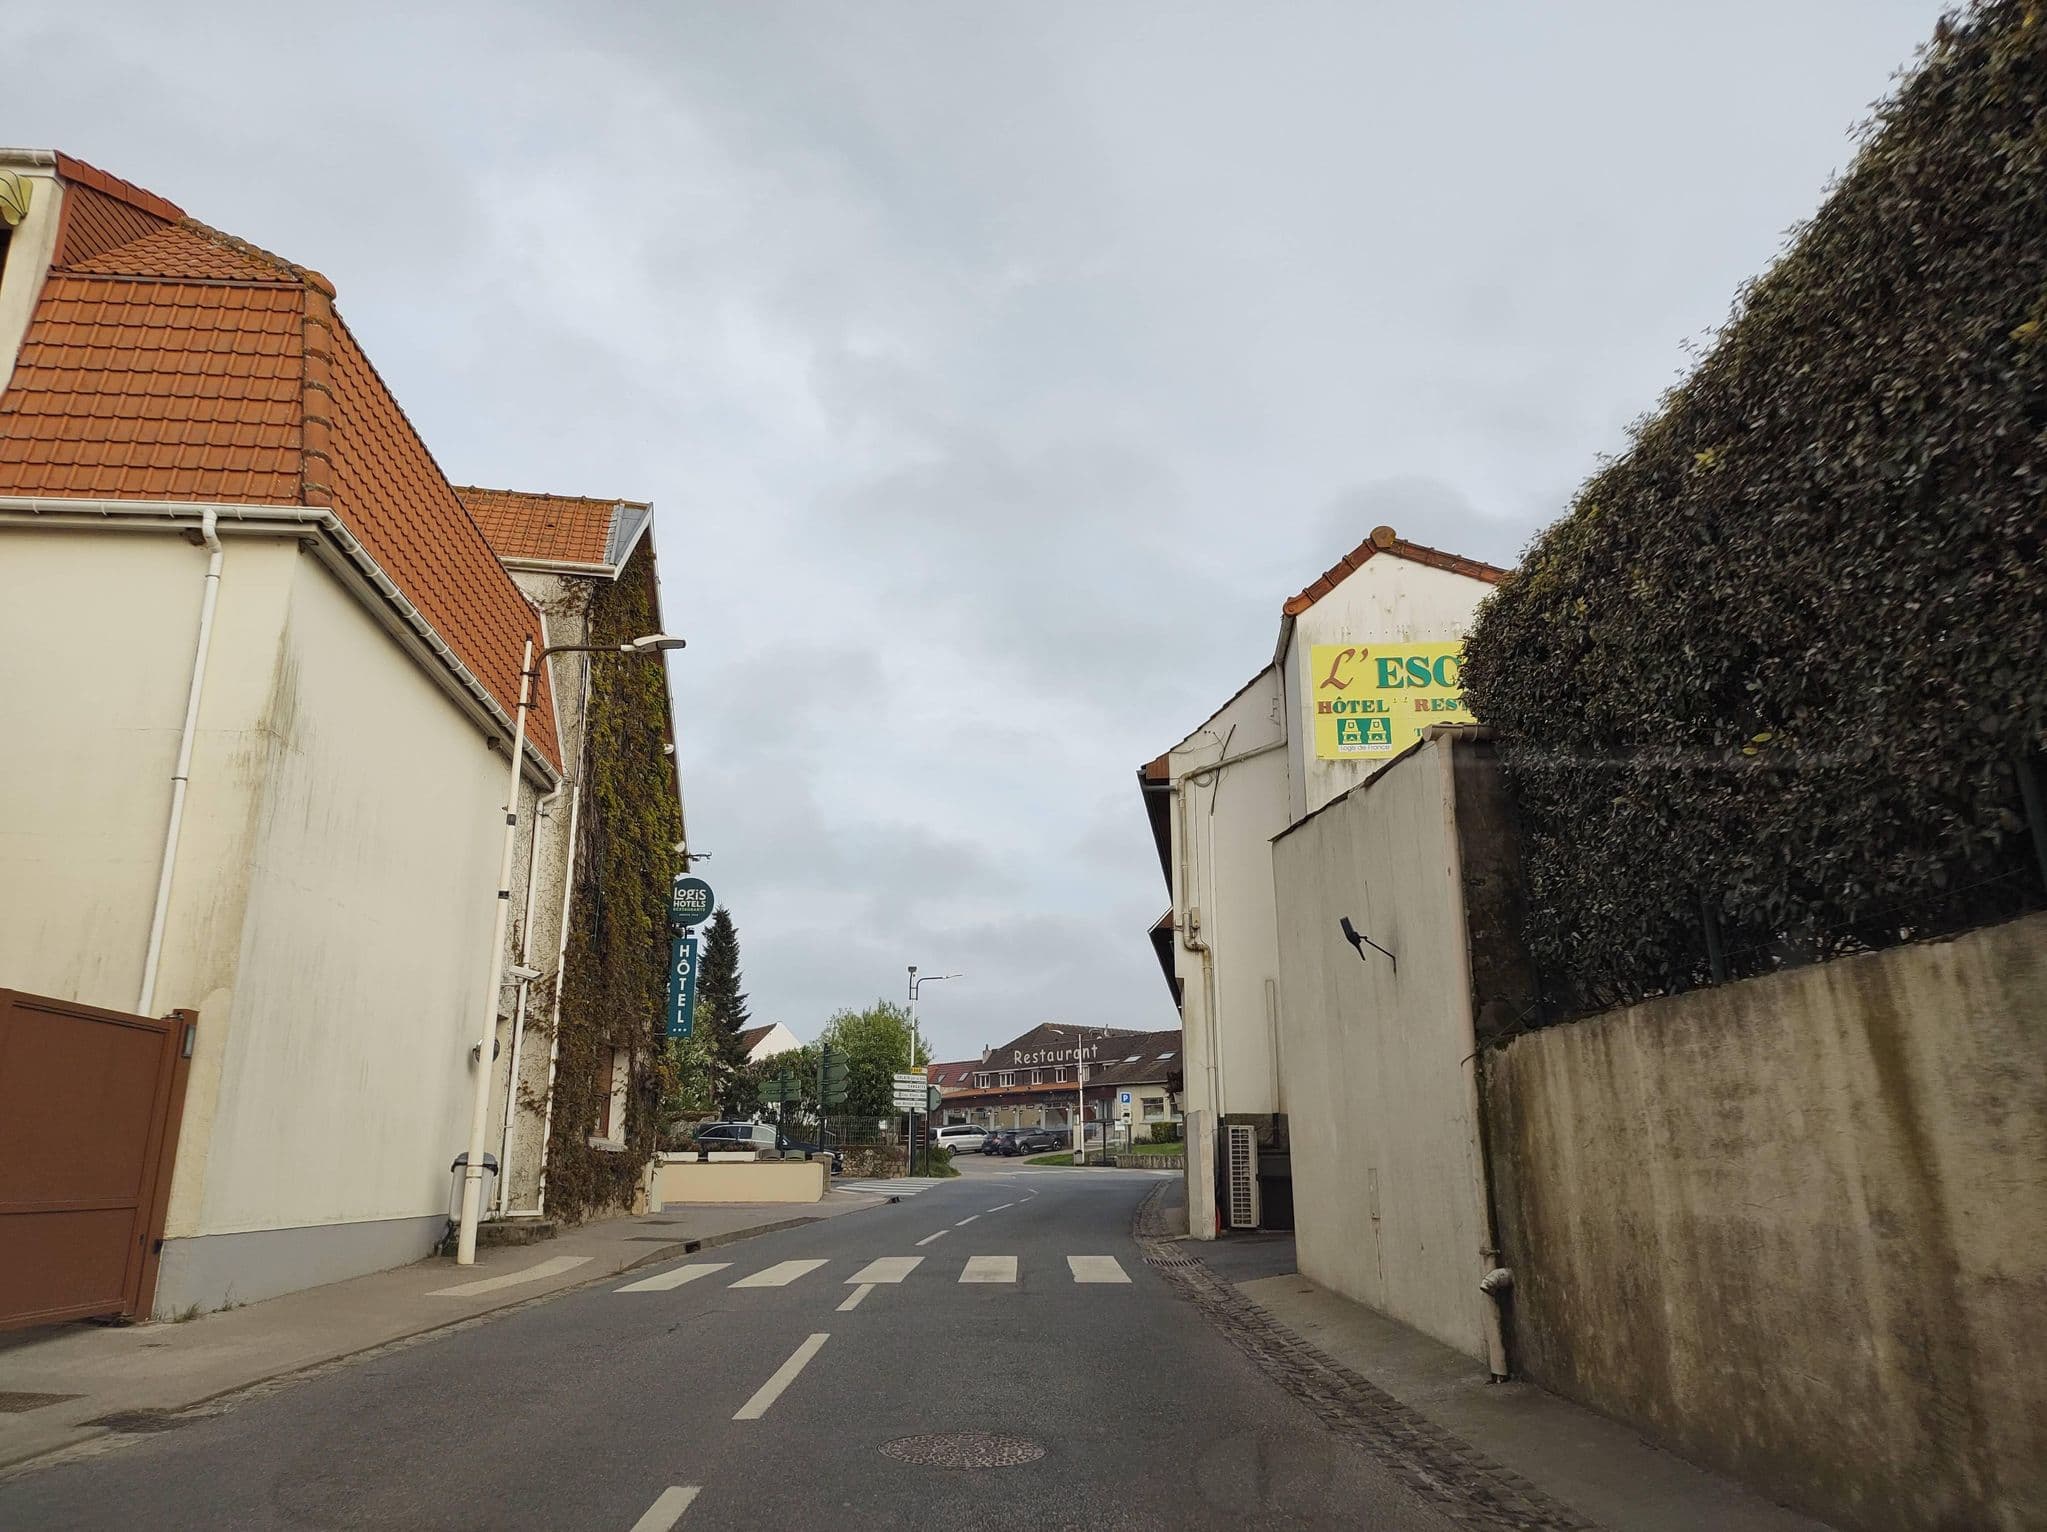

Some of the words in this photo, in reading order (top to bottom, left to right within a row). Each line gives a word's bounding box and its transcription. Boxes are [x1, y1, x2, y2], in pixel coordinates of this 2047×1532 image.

[1317, 696, 1390, 714] HÔTEL
[673, 900, 706, 908] HOTELS
[676, 944, 690, 1024] HÔTEL
[1014, 1043, 1098, 1065] Restaurant
